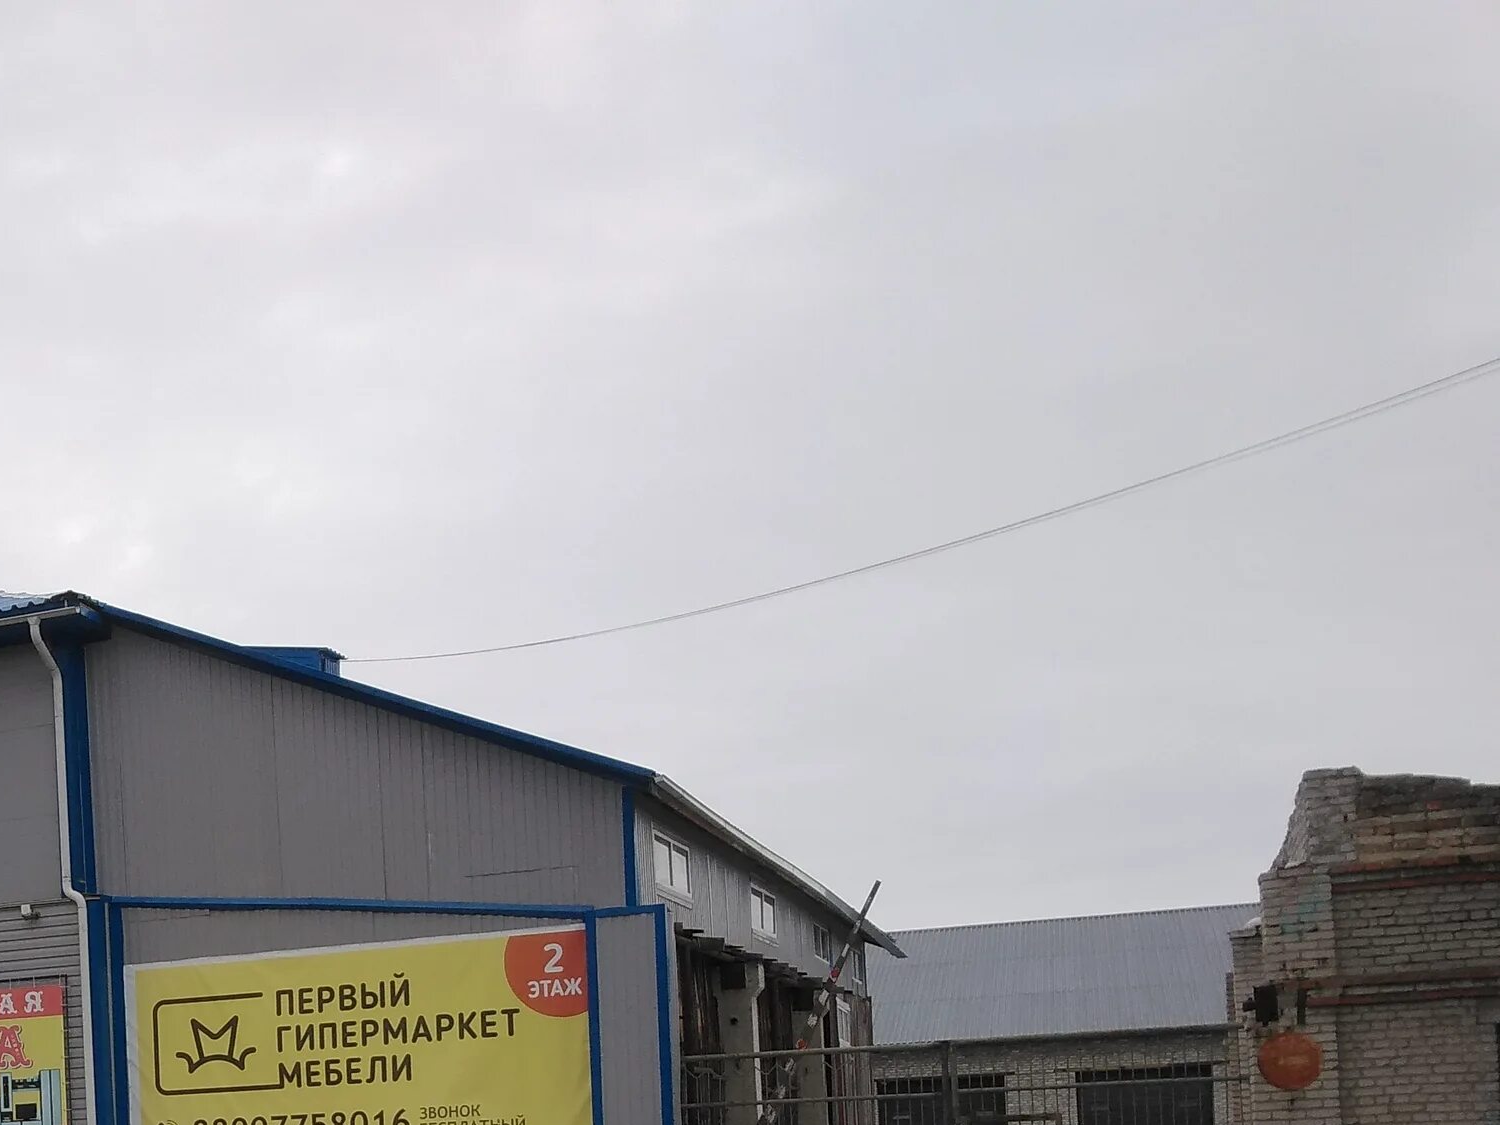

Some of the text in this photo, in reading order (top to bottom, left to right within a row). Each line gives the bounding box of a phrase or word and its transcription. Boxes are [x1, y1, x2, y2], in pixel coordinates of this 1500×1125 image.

[543, 942, 564, 974] 2
[275, 973, 410, 1017] ПЕРВЫЙ
[528, 977, 582, 999] ЭТАЖ
[276, 1008, 520, 1054] ГИПЕРМАРКЕТ
[277, 1054, 413, 1090] МЕБЕЛИ
[419, 1104, 481, 1120] ЗВОНОК
